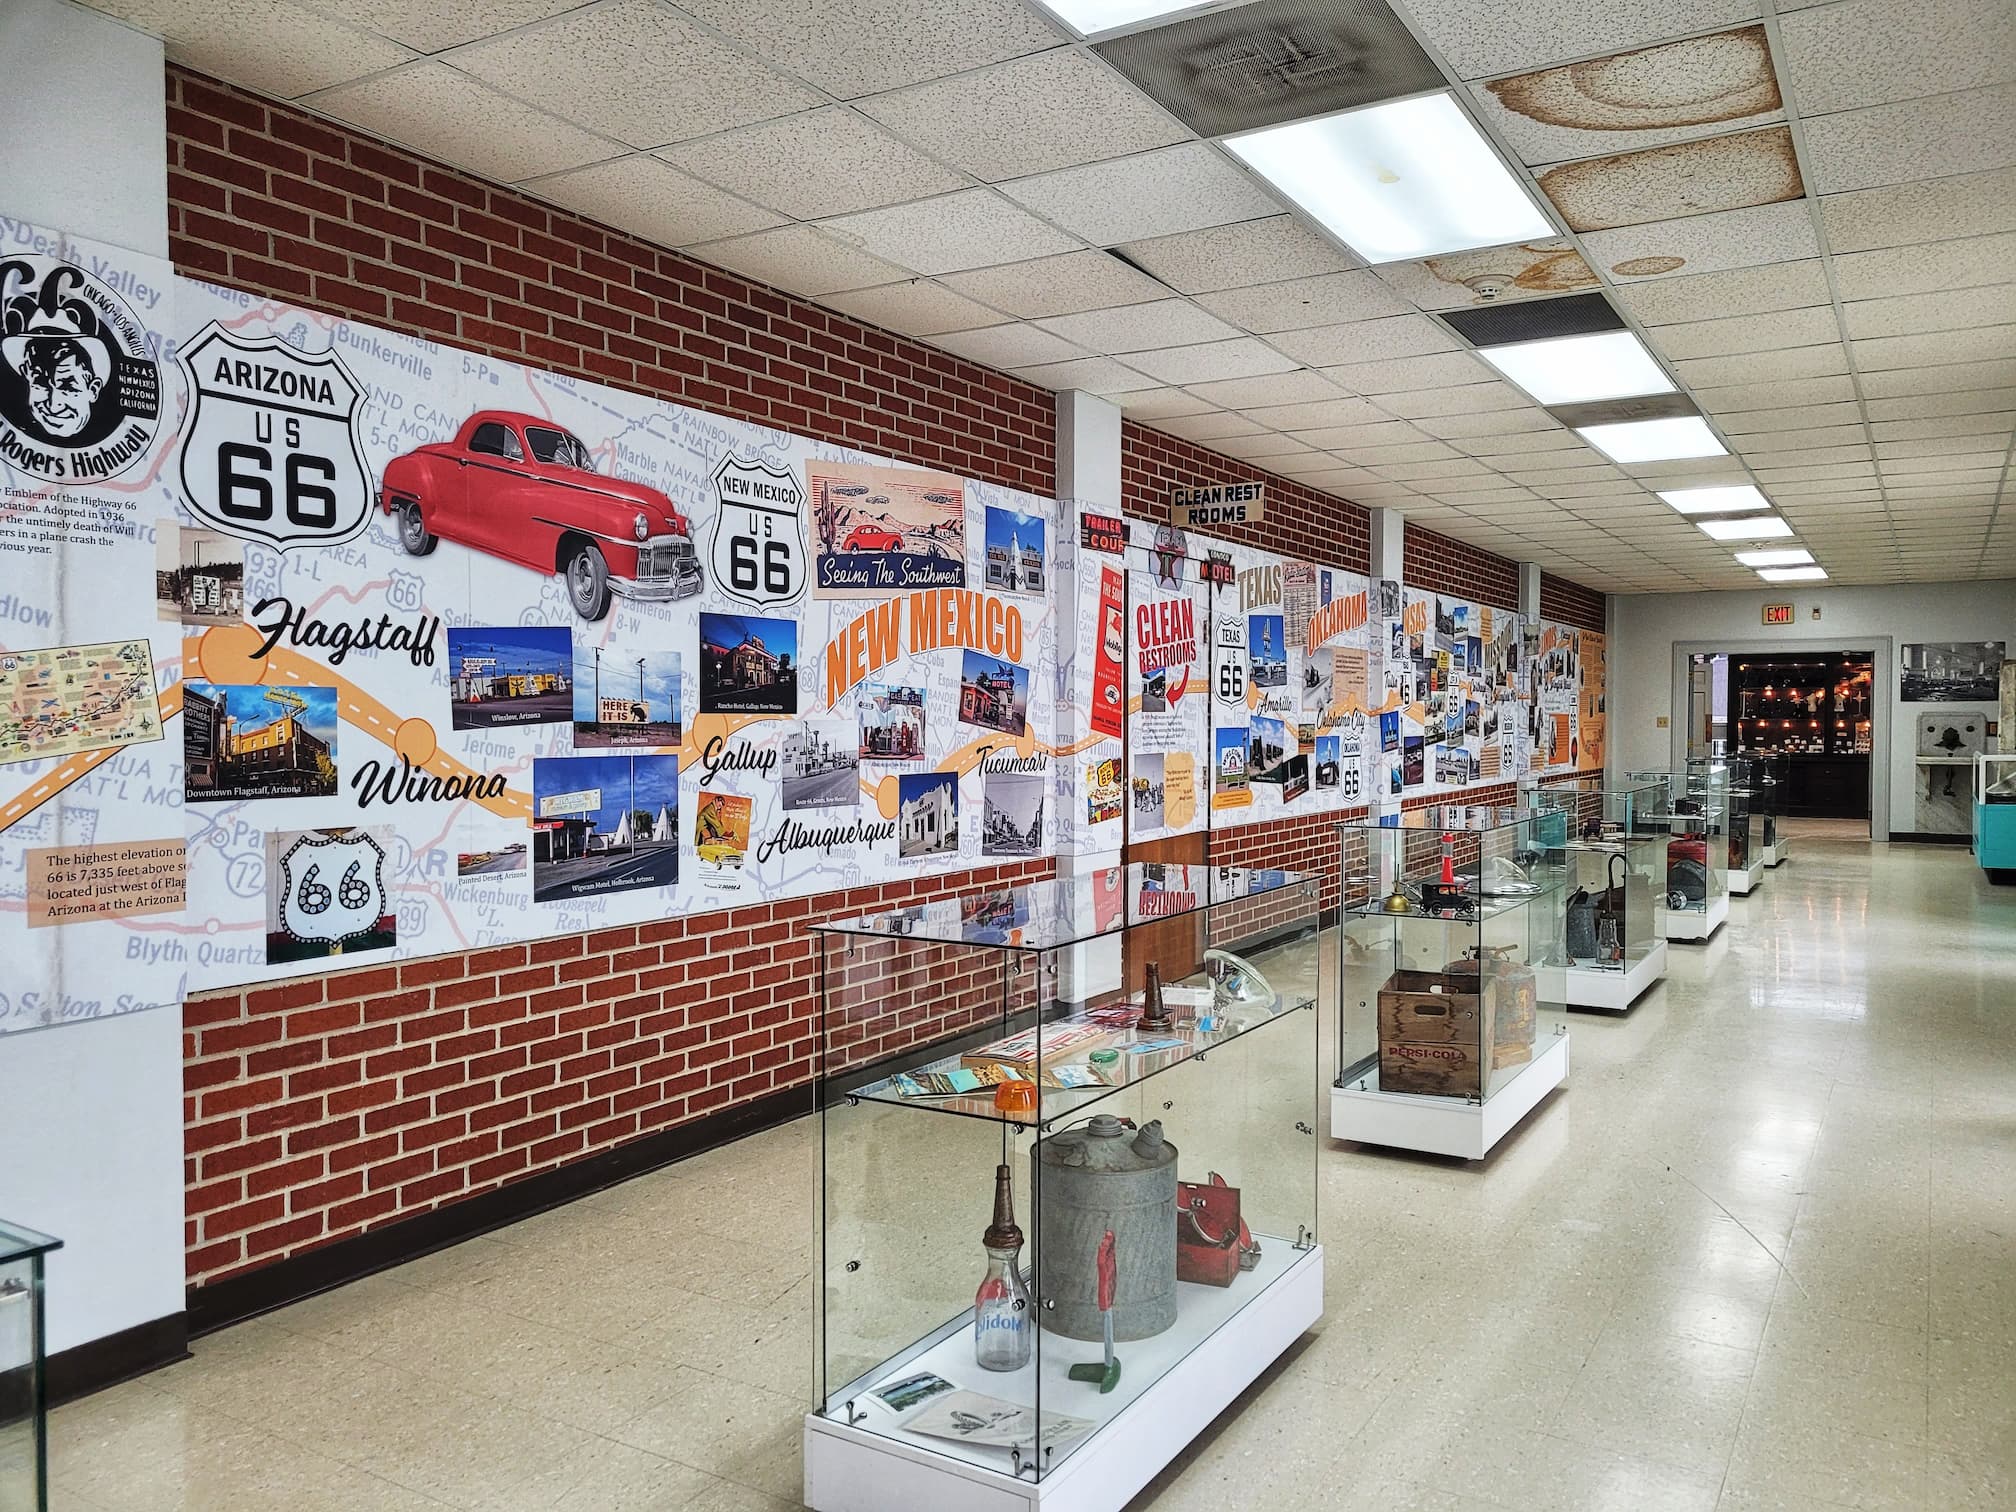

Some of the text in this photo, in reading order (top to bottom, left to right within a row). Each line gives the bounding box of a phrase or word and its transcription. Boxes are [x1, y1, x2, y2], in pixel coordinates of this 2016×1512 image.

[91, 255, 161, 309] Valley
[338, 323, 432, 381] Bunkerville
[120, 362, 155, 378] TEXAS
[214, 356, 336, 405] ARIZONA
[120, 388, 156, 400] ARIZONA
[120, 400, 156, 412] CALIFORNIA
[70, 424, 150, 478] Highway
[617, 442, 657, 473] Marble
[218, 441, 337, 529] 66
[723, 475, 796, 505] NEW MEXICO
[1175, 484, 1262, 507] CLEAN REST
[4, 488, 137, 511] Emblem of the Highway 66
[6, 515, 135, 536] the untimely death of Will
[44, 505, 85, 519] Adopted
[88, 509, 98, 519] in
[100, 511, 125, 521] 1936
[1085, 513, 1121, 534] TRAILER
[1189, 505, 1246, 525] ROOMS
[18, 529, 29, 539] in
[31, 533, 38, 541] a
[40, 531, 68, 545] plane
[70, 533, 96, 545] crash
[98, 537, 115, 547] the
[28, 545, 52, 555] year.
[251, 552, 278, 579] 93
[730, 536, 790, 594] 66
[822, 555, 869, 587] Seeing
[872, 554, 895, 585] The
[900, 557, 961, 586] Southwest
[394, 579, 417, 607] 66
[1237, 564, 1282, 613] TEXAS
[1136, 598, 1194, 649] CLEAN
[1307, 590, 1368, 658] OKLAHOMA
[1766, 606, 1790, 622] EXIT
[248, 597, 441, 667] Flagstaff
[1222, 629, 1240, 642] TEXAS
[826, 587, 1023, 715] NEW MEXICO
[1139, 640, 1197, 674] RESTROOMS
[991, 680, 1012, 690] MOTEL
[1221, 665, 1242, 697] 66
[491, 710, 541, 723] Winslow, Arizona
[602, 700, 628, 711] HERE
[602, 710, 628, 721] IT IS
[461, 732, 516, 760] Jerome
[629, 735, 649, 744] Arizona
[700, 735, 777, 787] Gallup
[976, 744, 1049, 778] Tucumcari
[350, 752, 508, 809] Winona
[1101, 772, 1112, 785] 66
[1344, 770, 1359, 795] 66
[187, 785, 301, 799] Downtown Flagstaff, Arizona
[757, 818, 895, 864] Albuquerque
[47, 848, 173, 867] The highest elevation
[47, 863, 175, 884] 66 is 7,335 feet above
[236, 861, 261, 888] 72
[504, 870, 527, 880] Arizona
[636, 875, 655, 884] Arizona
[47, 876, 187, 900] located just west of Flag
[297, 859, 371, 915] 66
[443, 881, 529, 911] Wickenburg
[47, 894, 180, 917] Arizona at the Arizona
